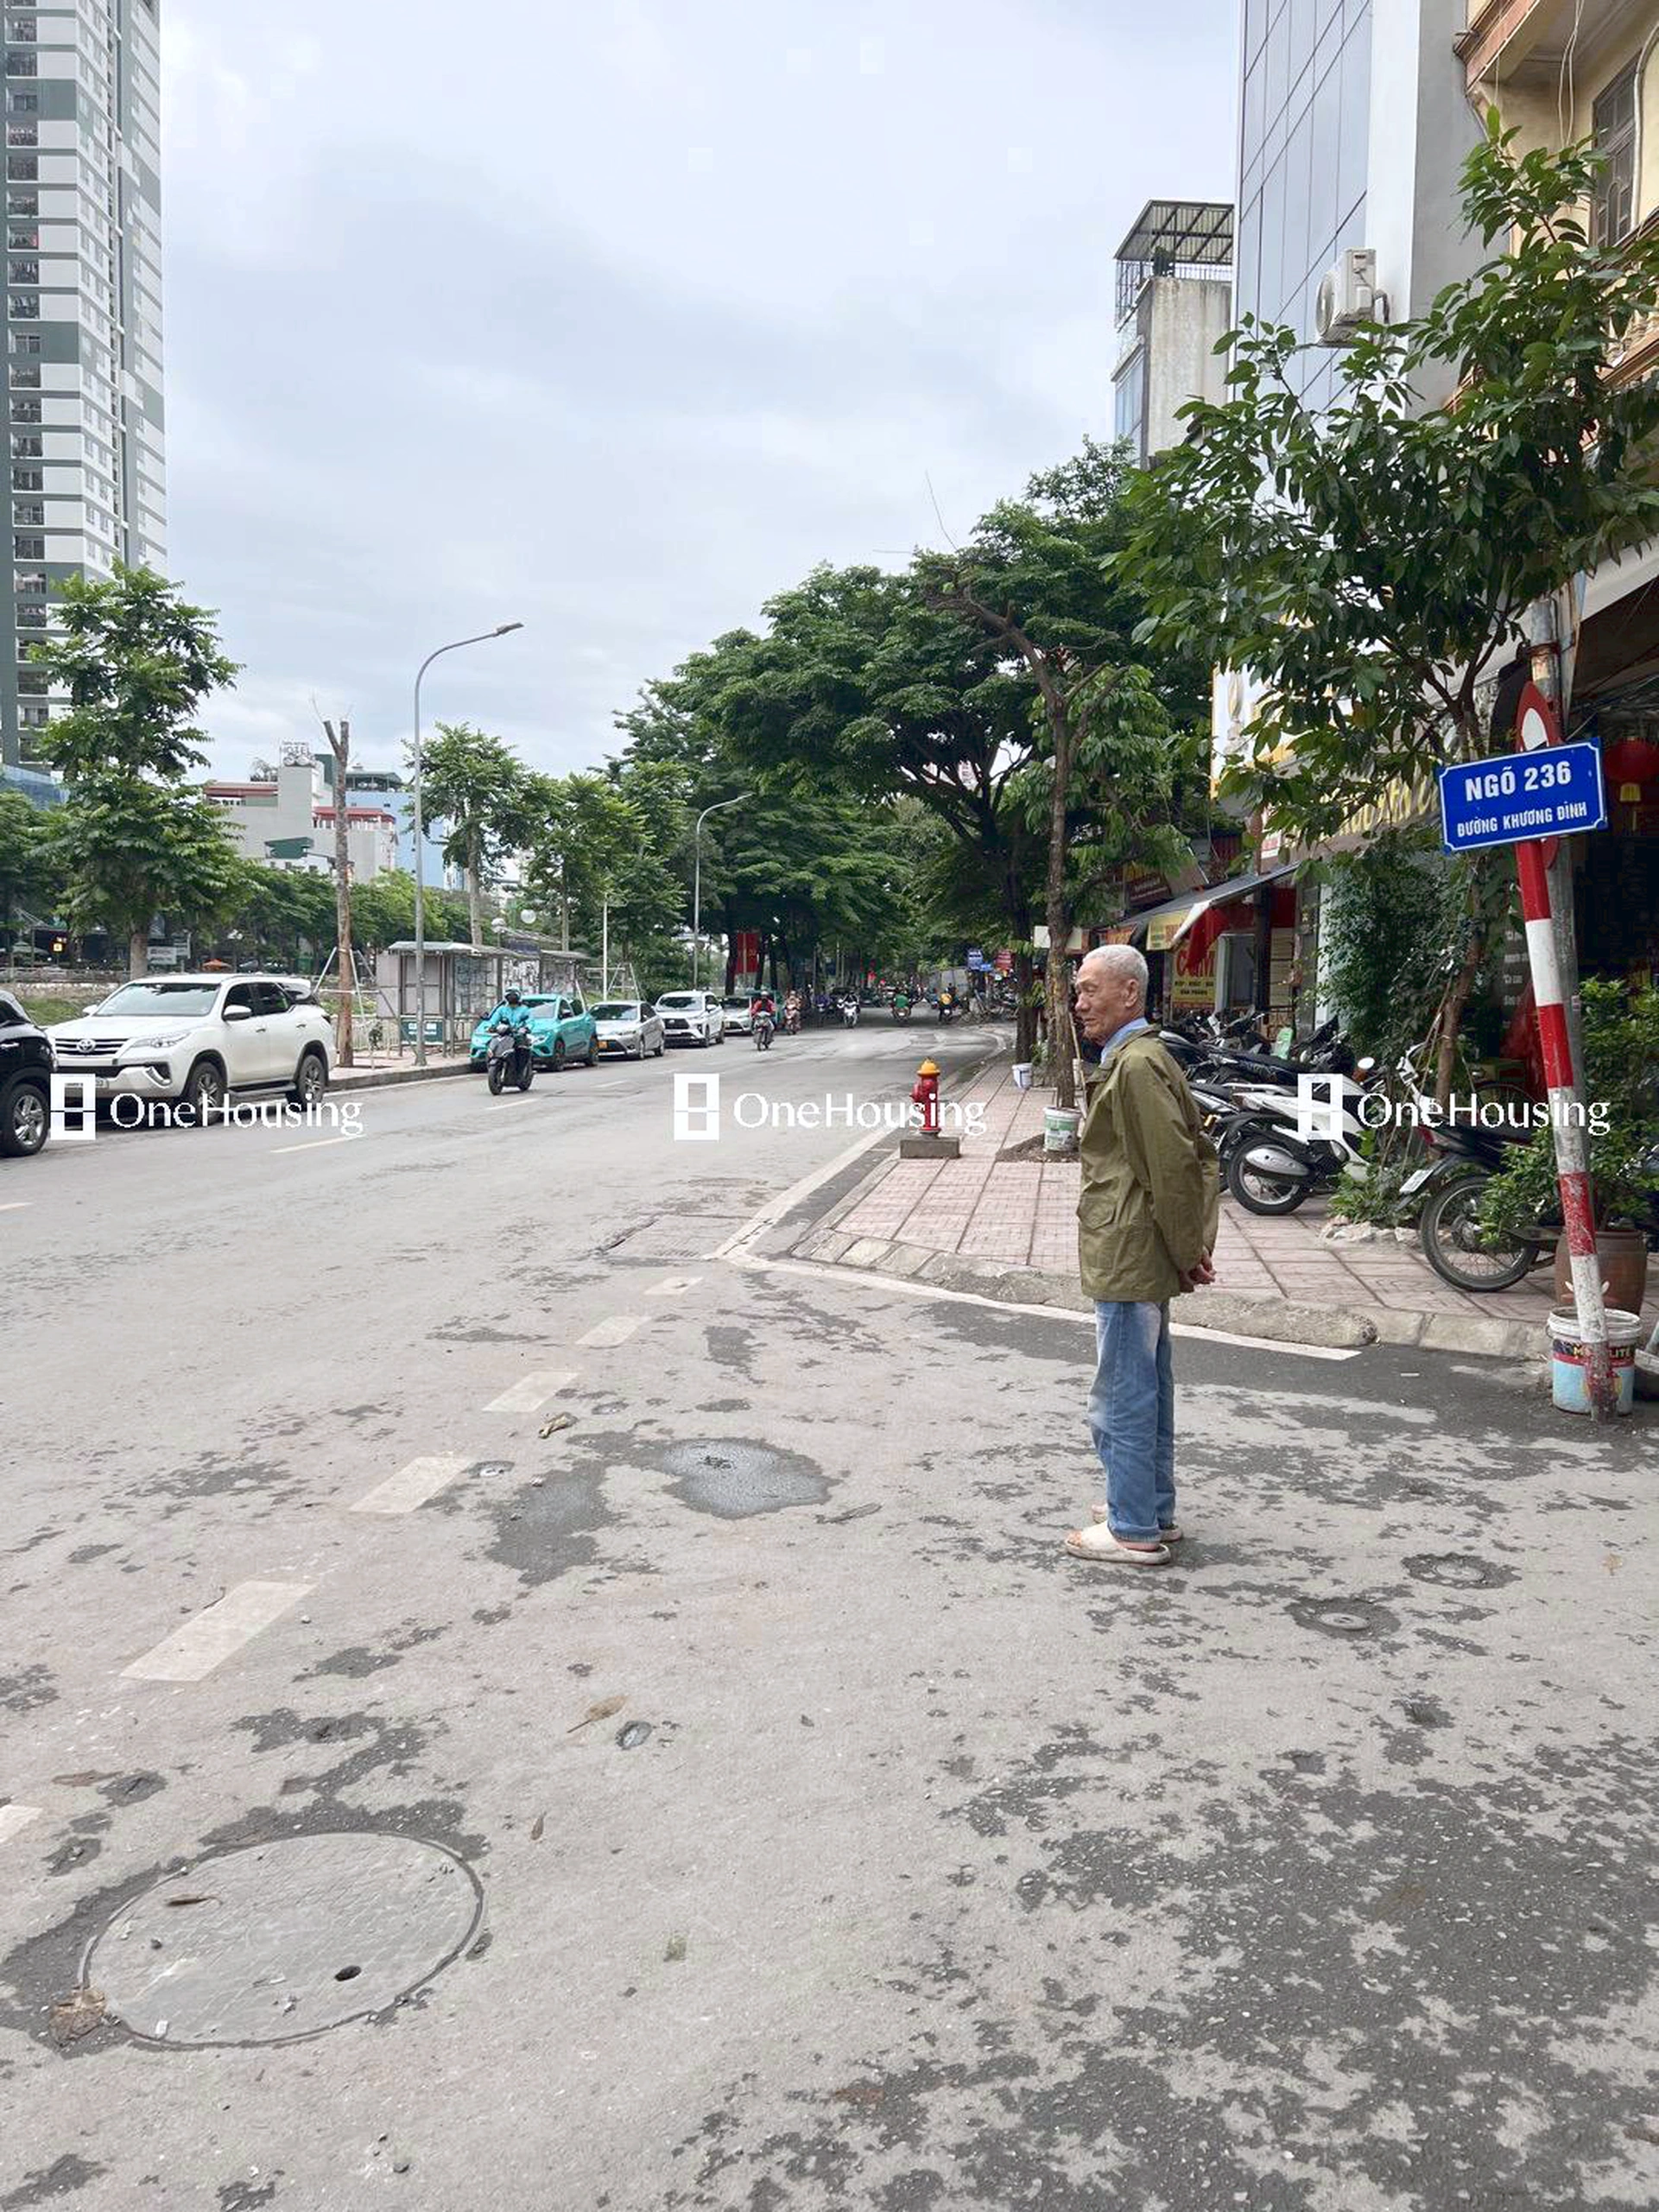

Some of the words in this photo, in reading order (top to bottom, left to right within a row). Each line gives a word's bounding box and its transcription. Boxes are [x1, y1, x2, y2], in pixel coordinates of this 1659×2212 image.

[1465, 765, 1516, 802] NGÕ
[1524, 761, 1572, 791] 236
[1457, 815, 1498, 838] ĐƯỜNG
[1503, 808, 1553, 830] KHƯƠNG
[1557, 801, 1587, 821] ĐÌNH
